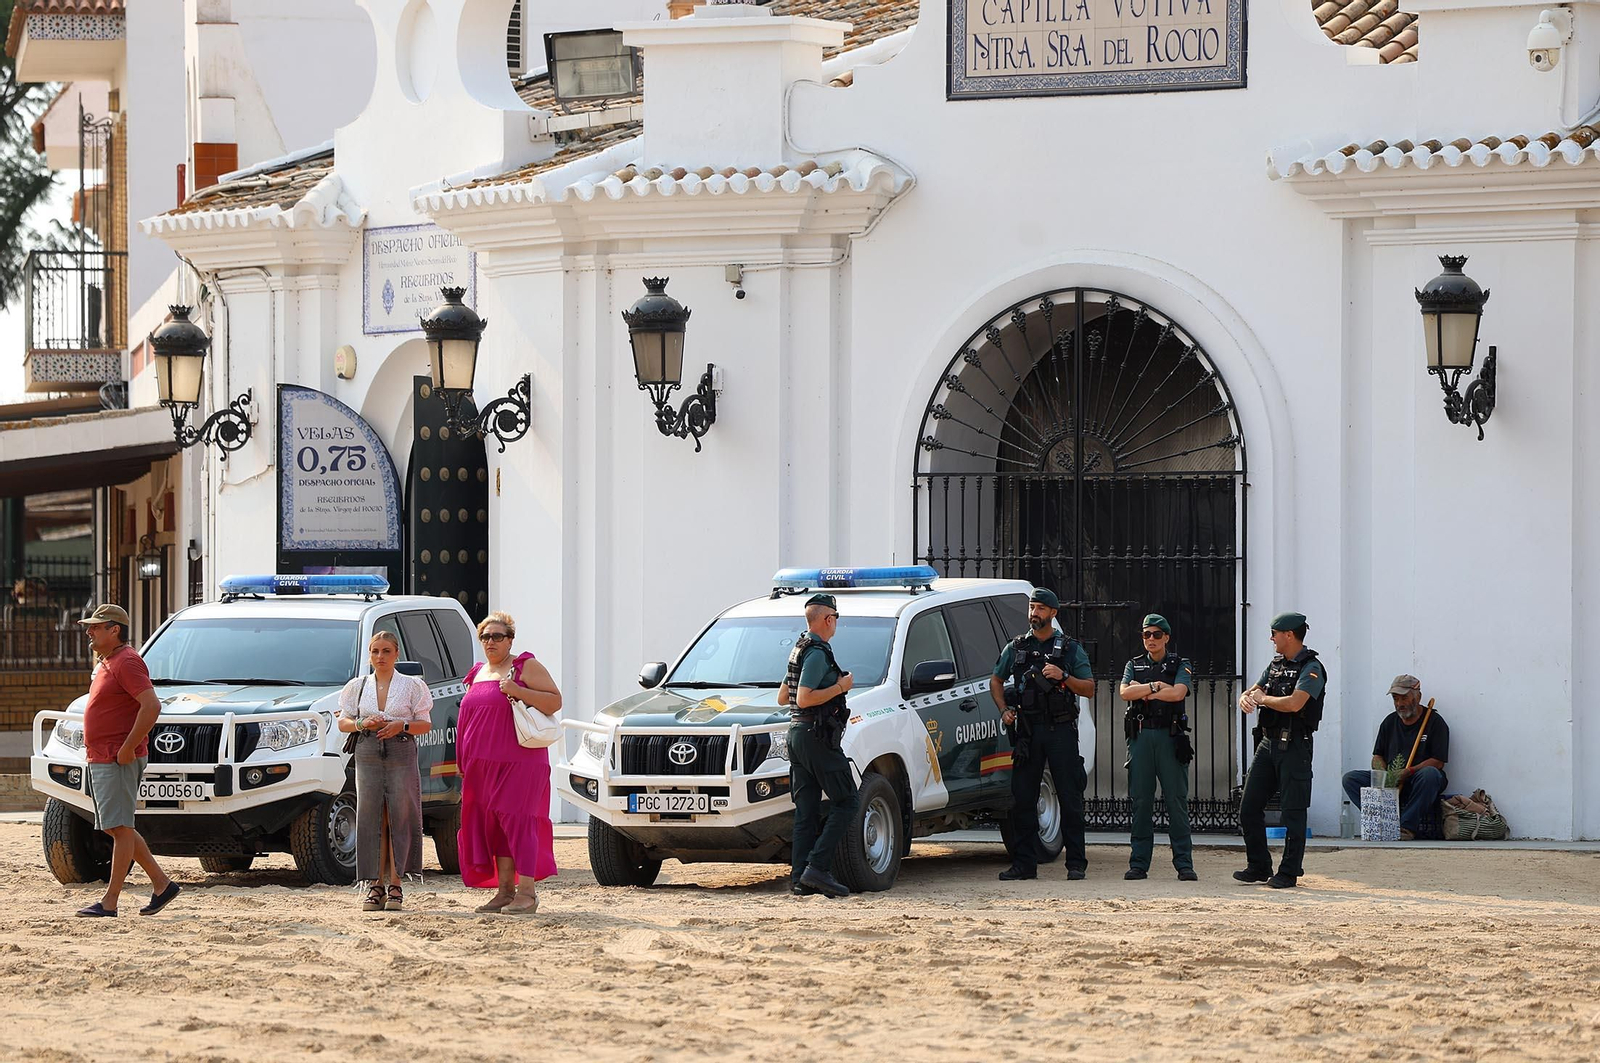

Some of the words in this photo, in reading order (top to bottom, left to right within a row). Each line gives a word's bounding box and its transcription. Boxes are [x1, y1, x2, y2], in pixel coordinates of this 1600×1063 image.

[982, 0, 1091, 26] CAPILLA
[972, 32, 1036, 71] NTRA.
[1047, 30, 1092, 68] SRA.
[1103, 38, 1134, 66] DEL
[1146, 25, 1220, 63] ROCIO
[371, 237, 424, 255] DESPACHO
[400, 272, 454, 289] RECUERDOS
[297, 426, 355, 440] VELAS
[297, 445, 366, 475] 0,75
[371, 462, 376, 470] €
[298, 478, 343, 487] DESPACHO
[343, 478, 376, 487] OFICIAL
[317, 495, 366, 504] RECUERDOS
[956, 719, 997, 745] GUARDIA
[140, 784, 156, 798] GC
[158, 784, 192, 798] 0056
[638, 796, 661, 810] PGC
[665, 796, 695, 811] 1272
